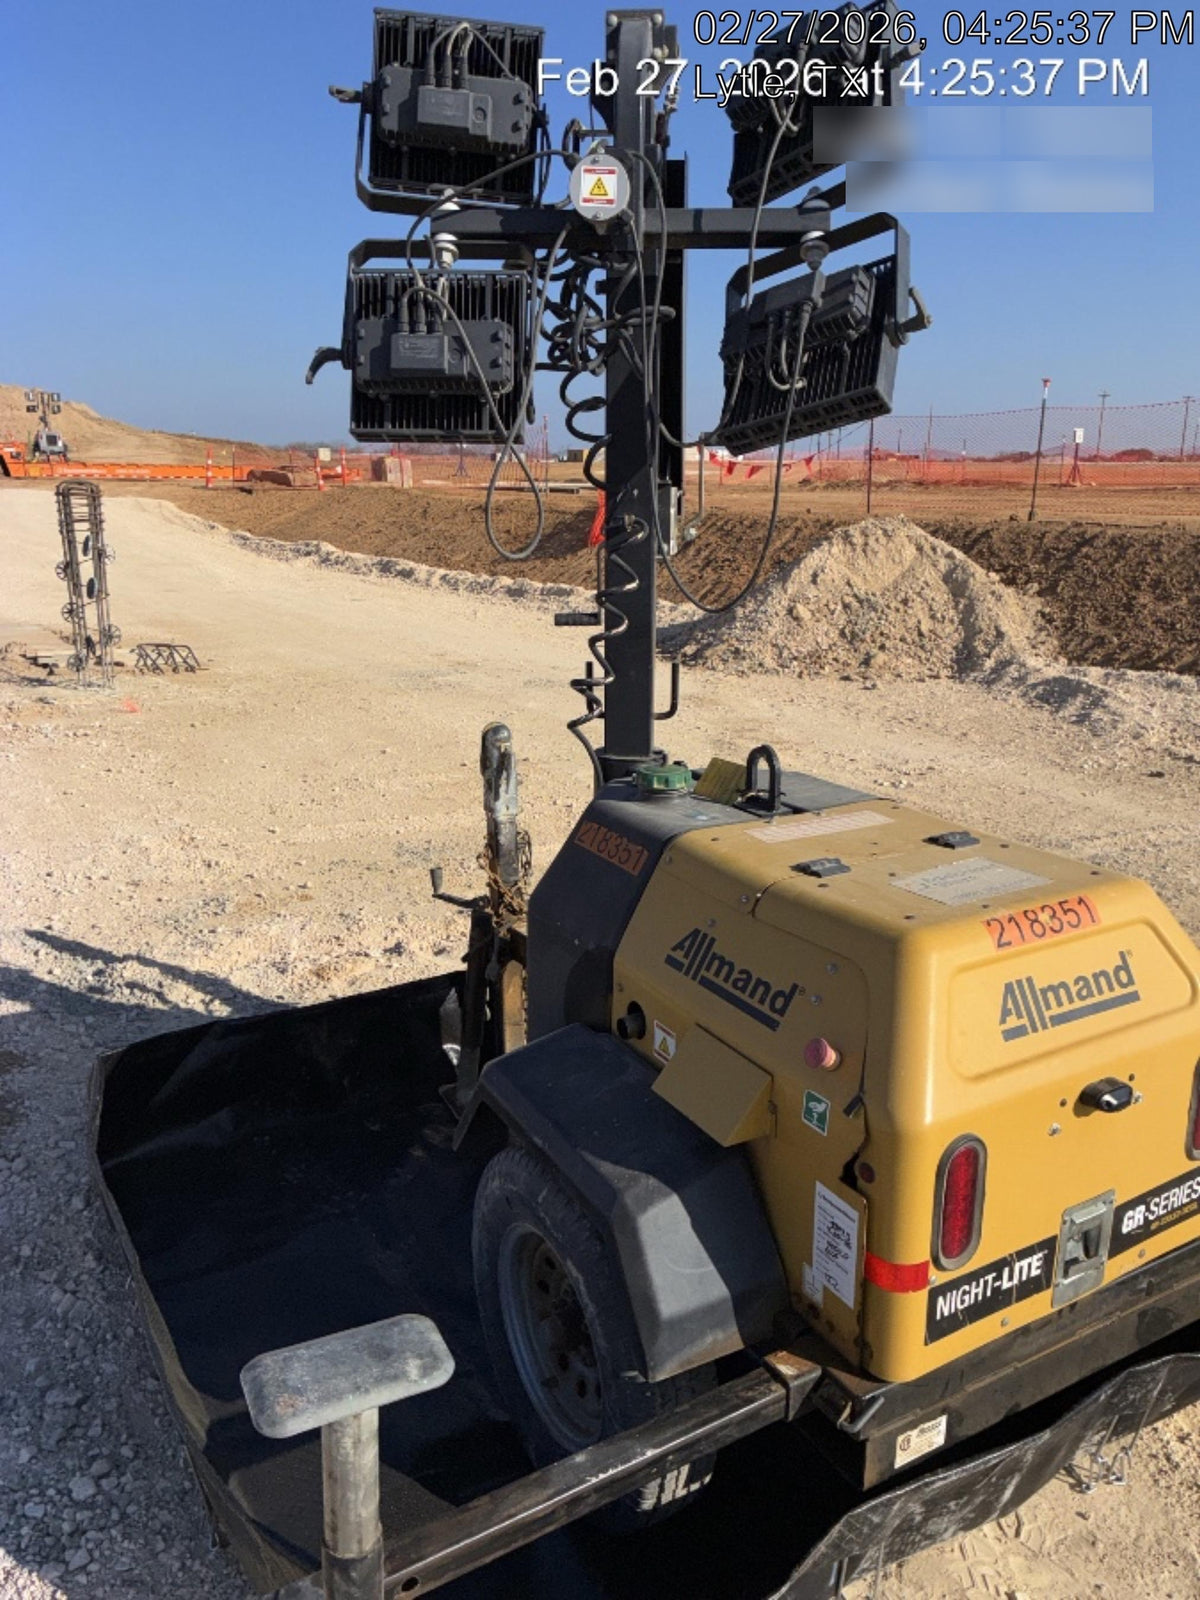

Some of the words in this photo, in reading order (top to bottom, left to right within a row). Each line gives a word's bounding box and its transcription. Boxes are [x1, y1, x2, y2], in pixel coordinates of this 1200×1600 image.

[986, 895, 1096, 948] 218351
[671, 927, 799, 1018] Allmand
[999, 950, 1135, 1014] Allmand
[1122, 1176, 1200, 1234] GR-SERIES
[936, 1252, 1044, 1320] NIGHT-LITE
